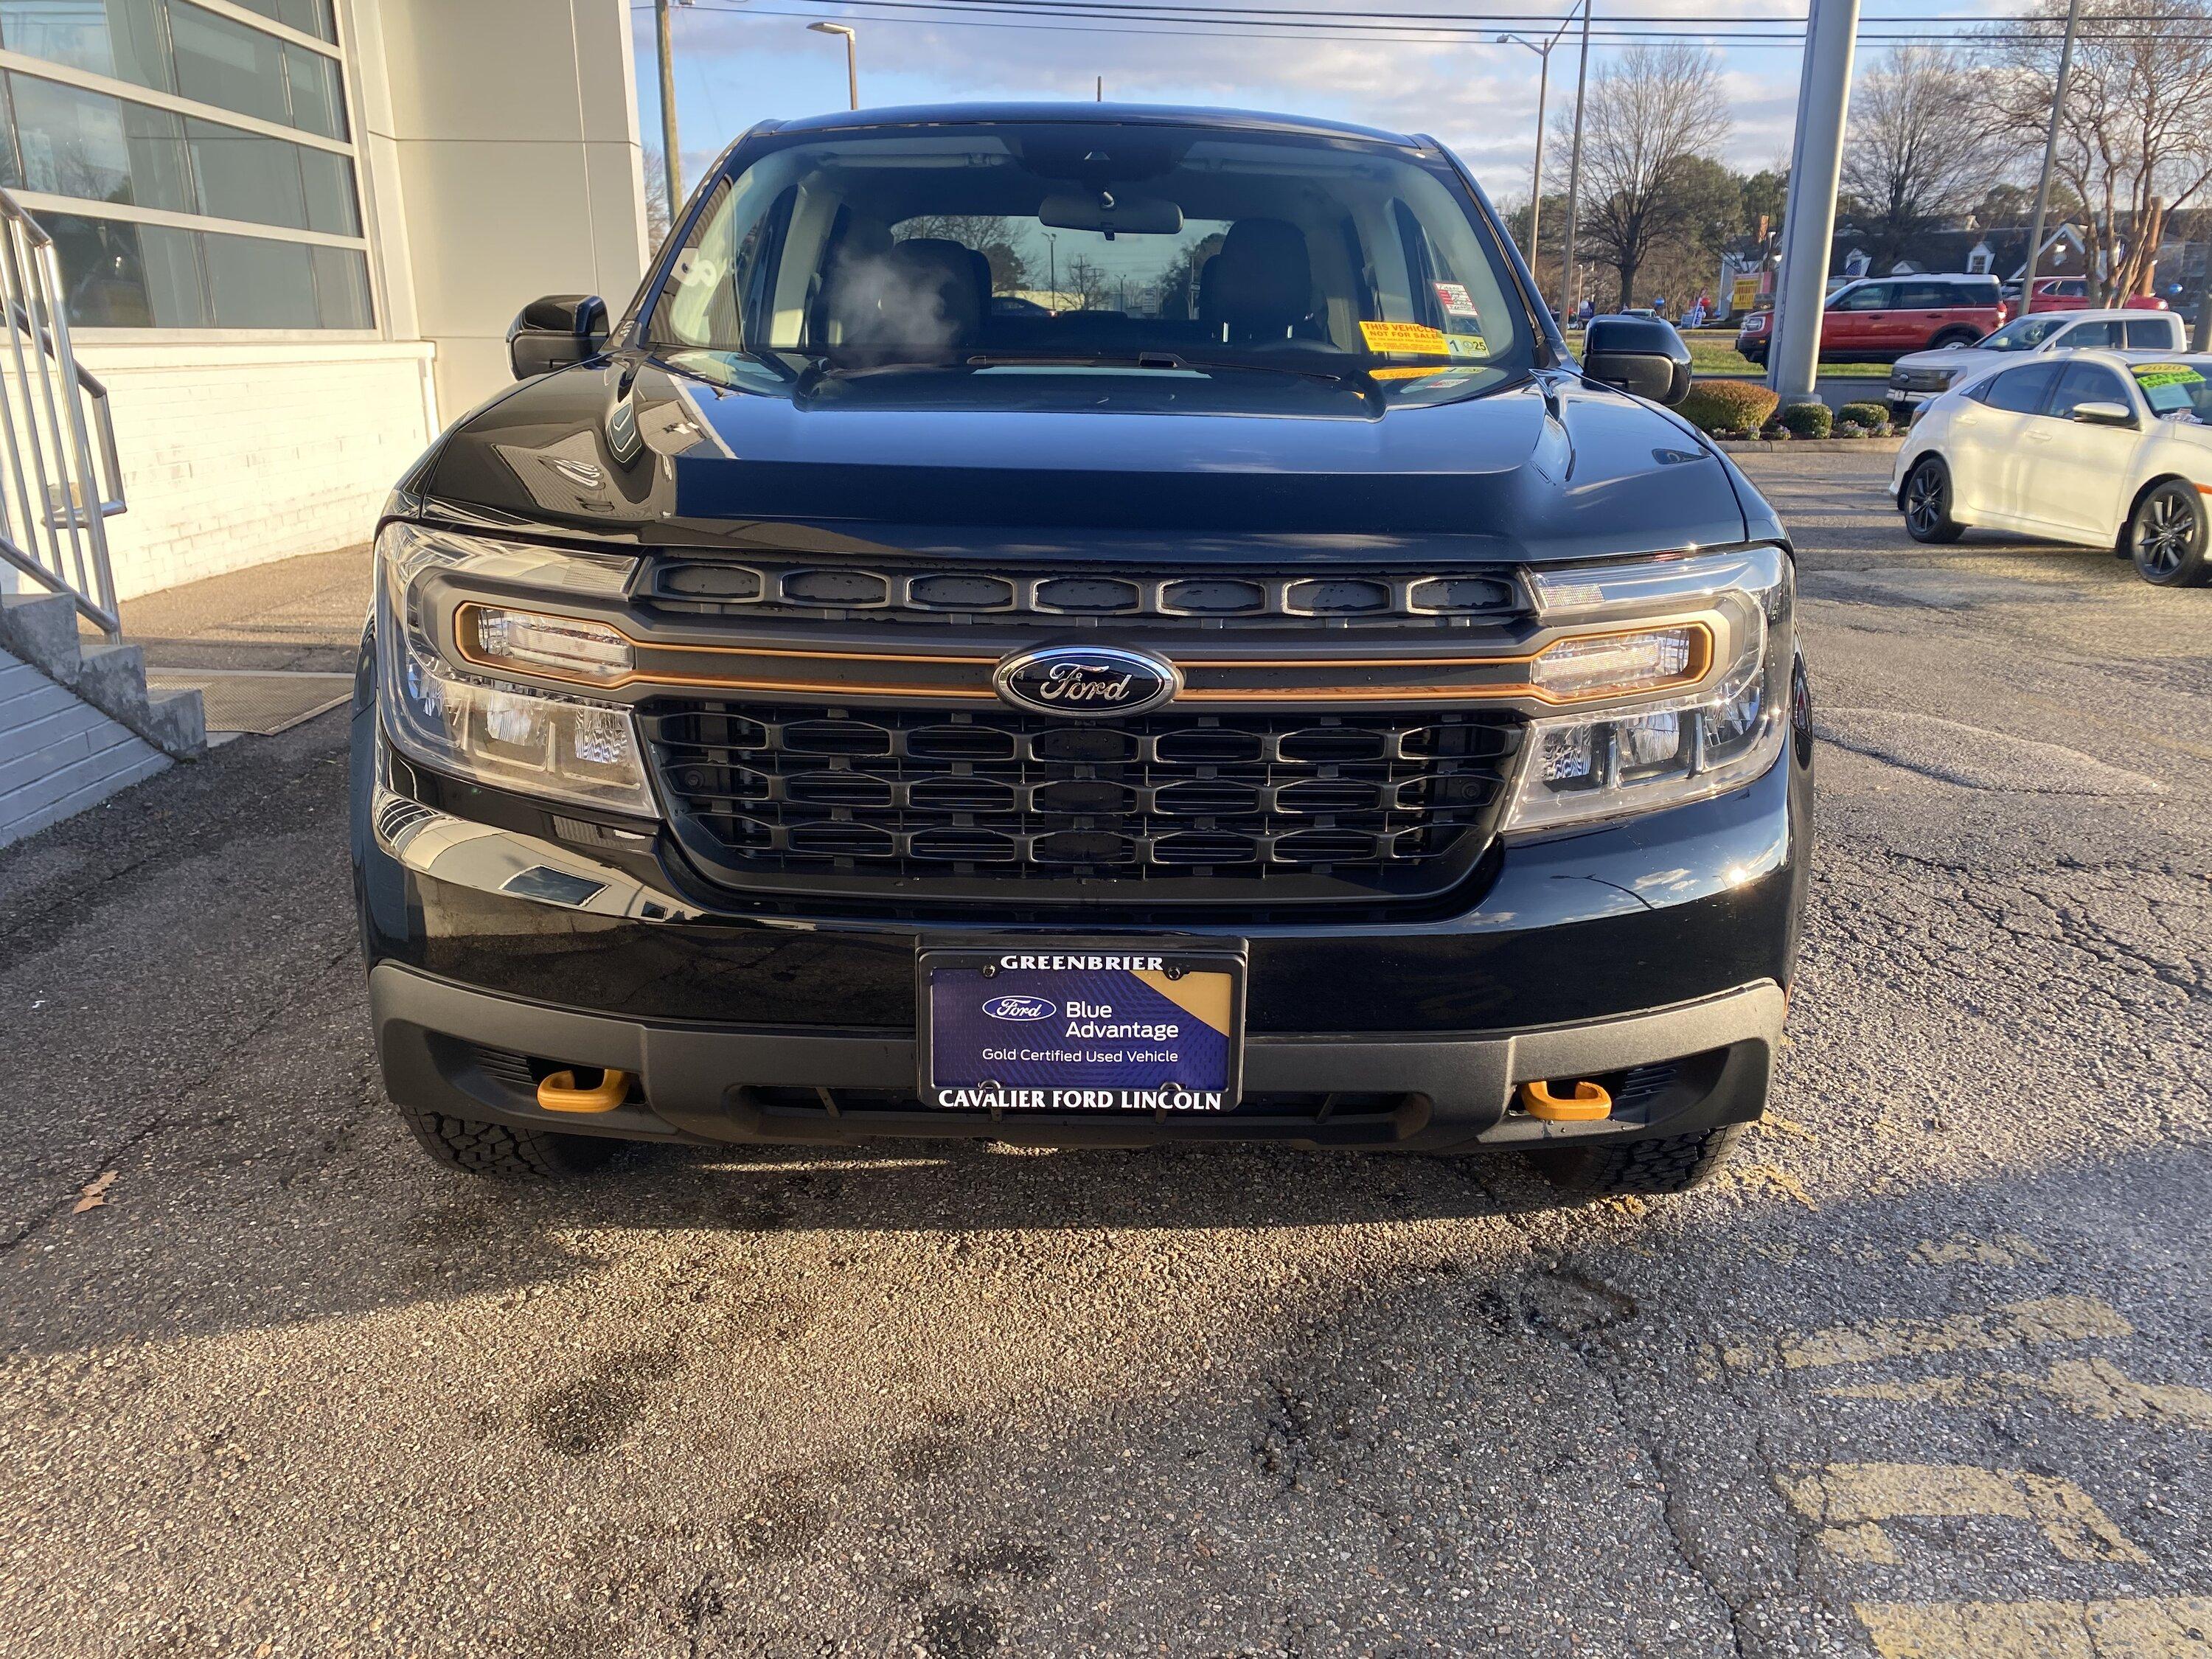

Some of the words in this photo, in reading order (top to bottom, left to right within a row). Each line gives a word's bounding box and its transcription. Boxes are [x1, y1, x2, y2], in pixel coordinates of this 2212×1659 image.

[1391, 324, 1437, 333] VEHICLE
[1450, 339, 1459, 352] 1
[1472, 341, 1486, 351] 25
[2147, 380, 2170, 388] SUN
[1040, 663, 1132, 701] Ford
[1000, 955, 1164, 971] GREENBRIER
[996, 998, 1042, 1017] Ford
[1066, 1001, 1113, 1018] Blue
[1065, 1020, 1179, 1041] Advantage
[981, 1048, 1016, 1060] Gold
[1020, 1048, 1082, 1062] Certified
[1086, 1050, 1123, 1062] Used
[1127, 1050, 1178, 1062] Vehicle
[938, 1089, 1046, 1107] CAVALIER
[1052, 1090, 1113, 1108] FORD
[1121, 1091, 1222, 1110] LINCOLN
